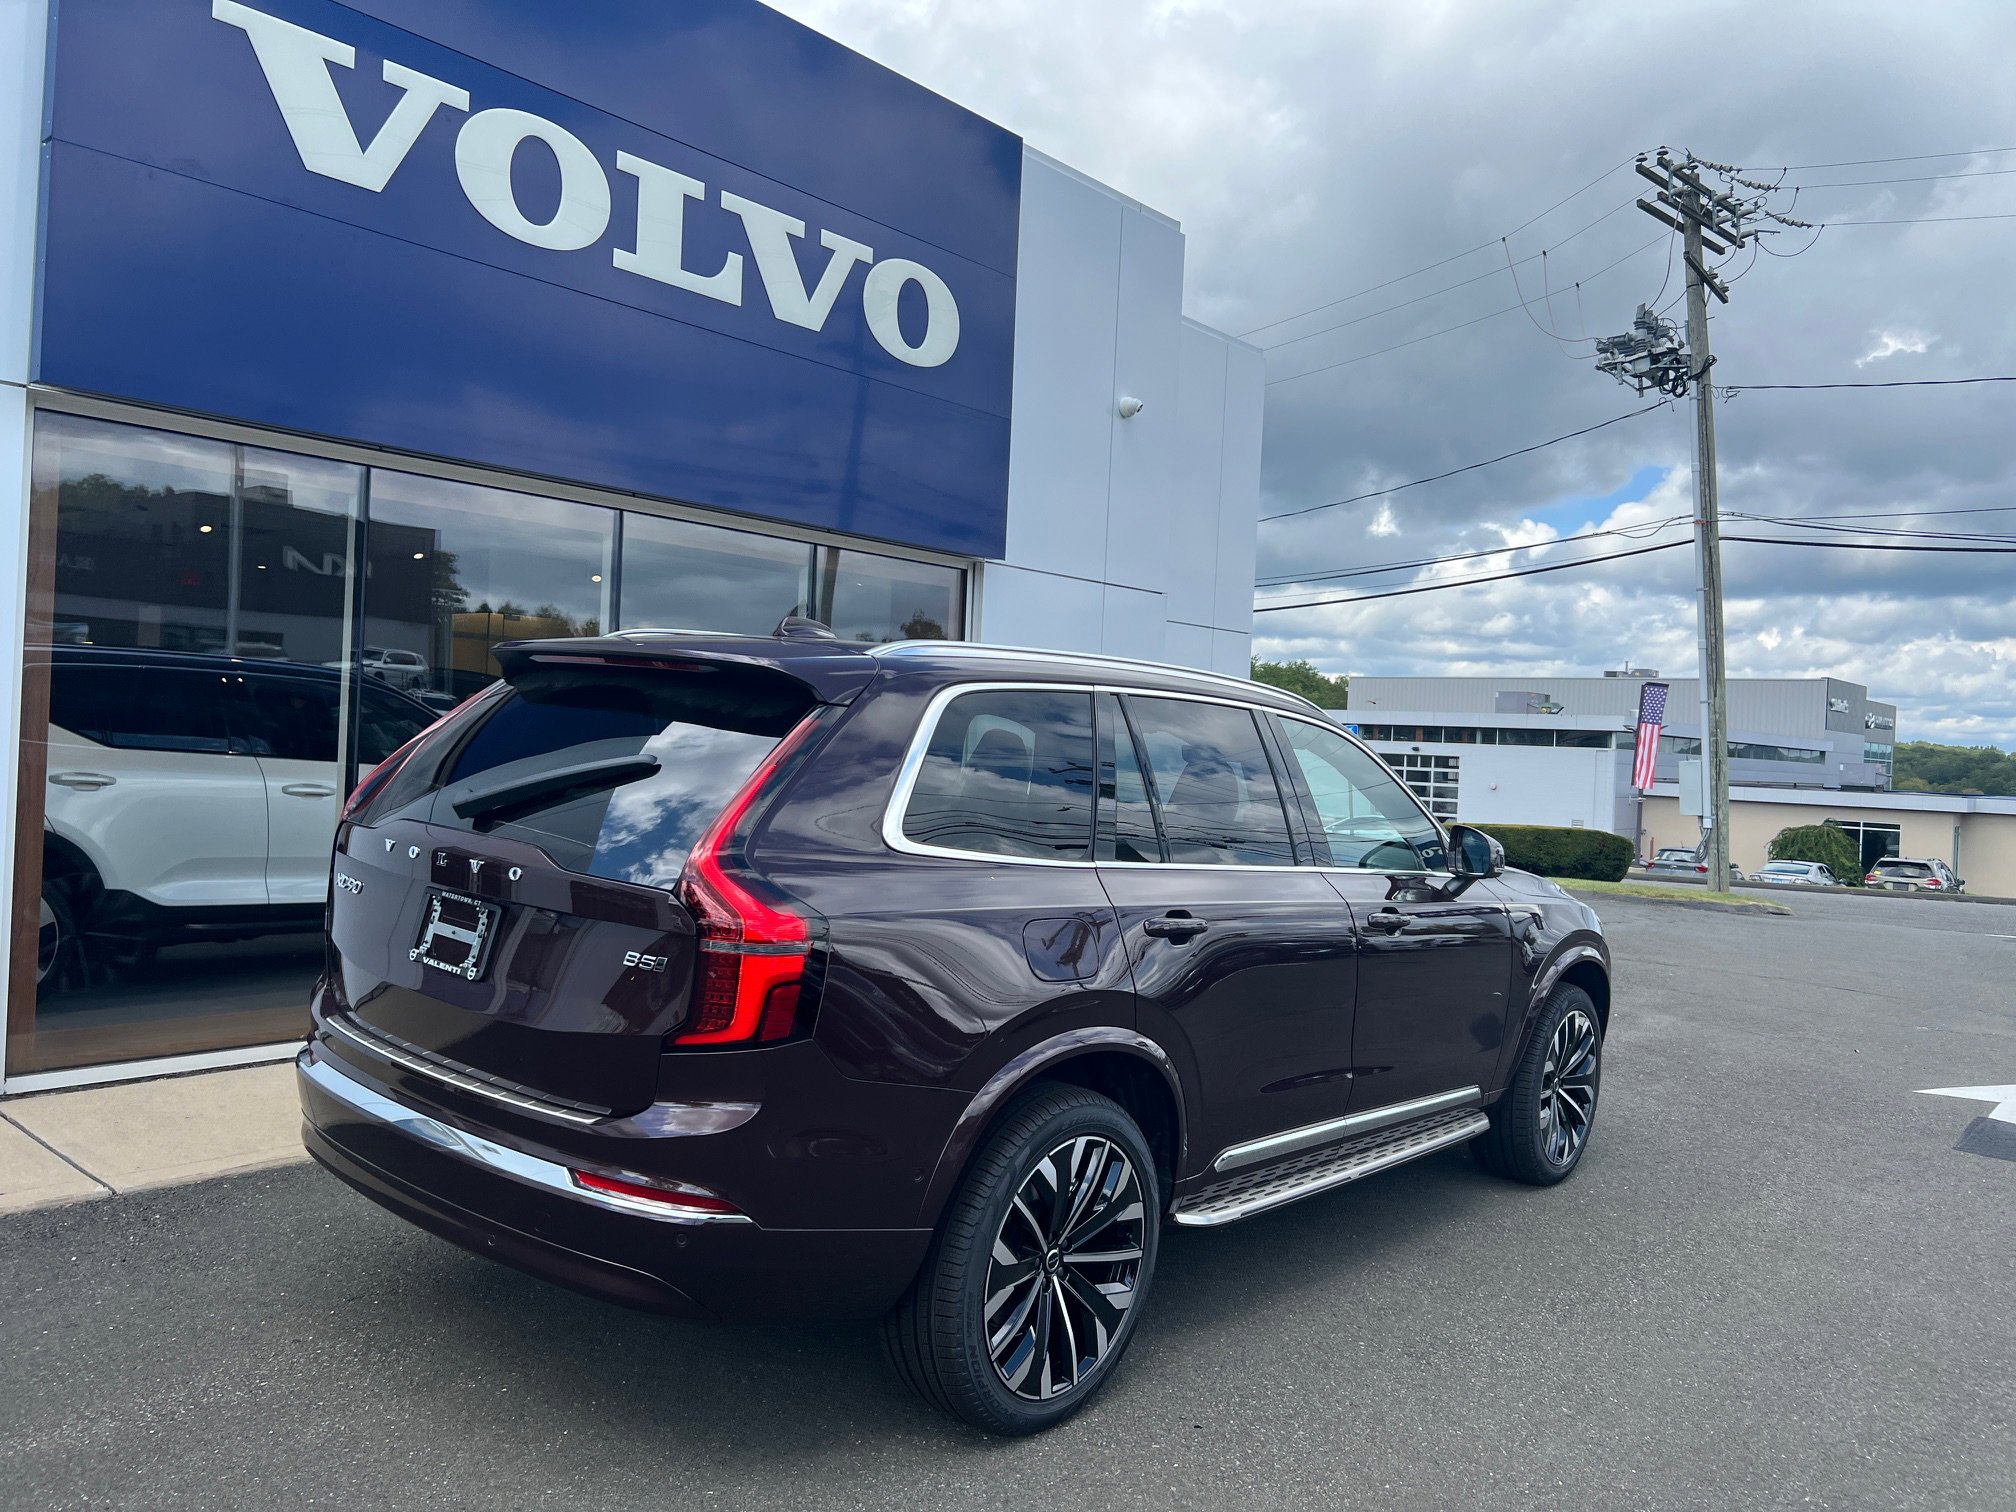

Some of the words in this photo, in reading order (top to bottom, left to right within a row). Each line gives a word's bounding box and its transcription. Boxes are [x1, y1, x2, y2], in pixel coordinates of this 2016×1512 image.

[212, 0, 961, 368] VOLVO
[385, 838, 522, 881] VOLVO
[336, 872, 364, 895] XC90
[422, 956, 462, 975] VALENTI
